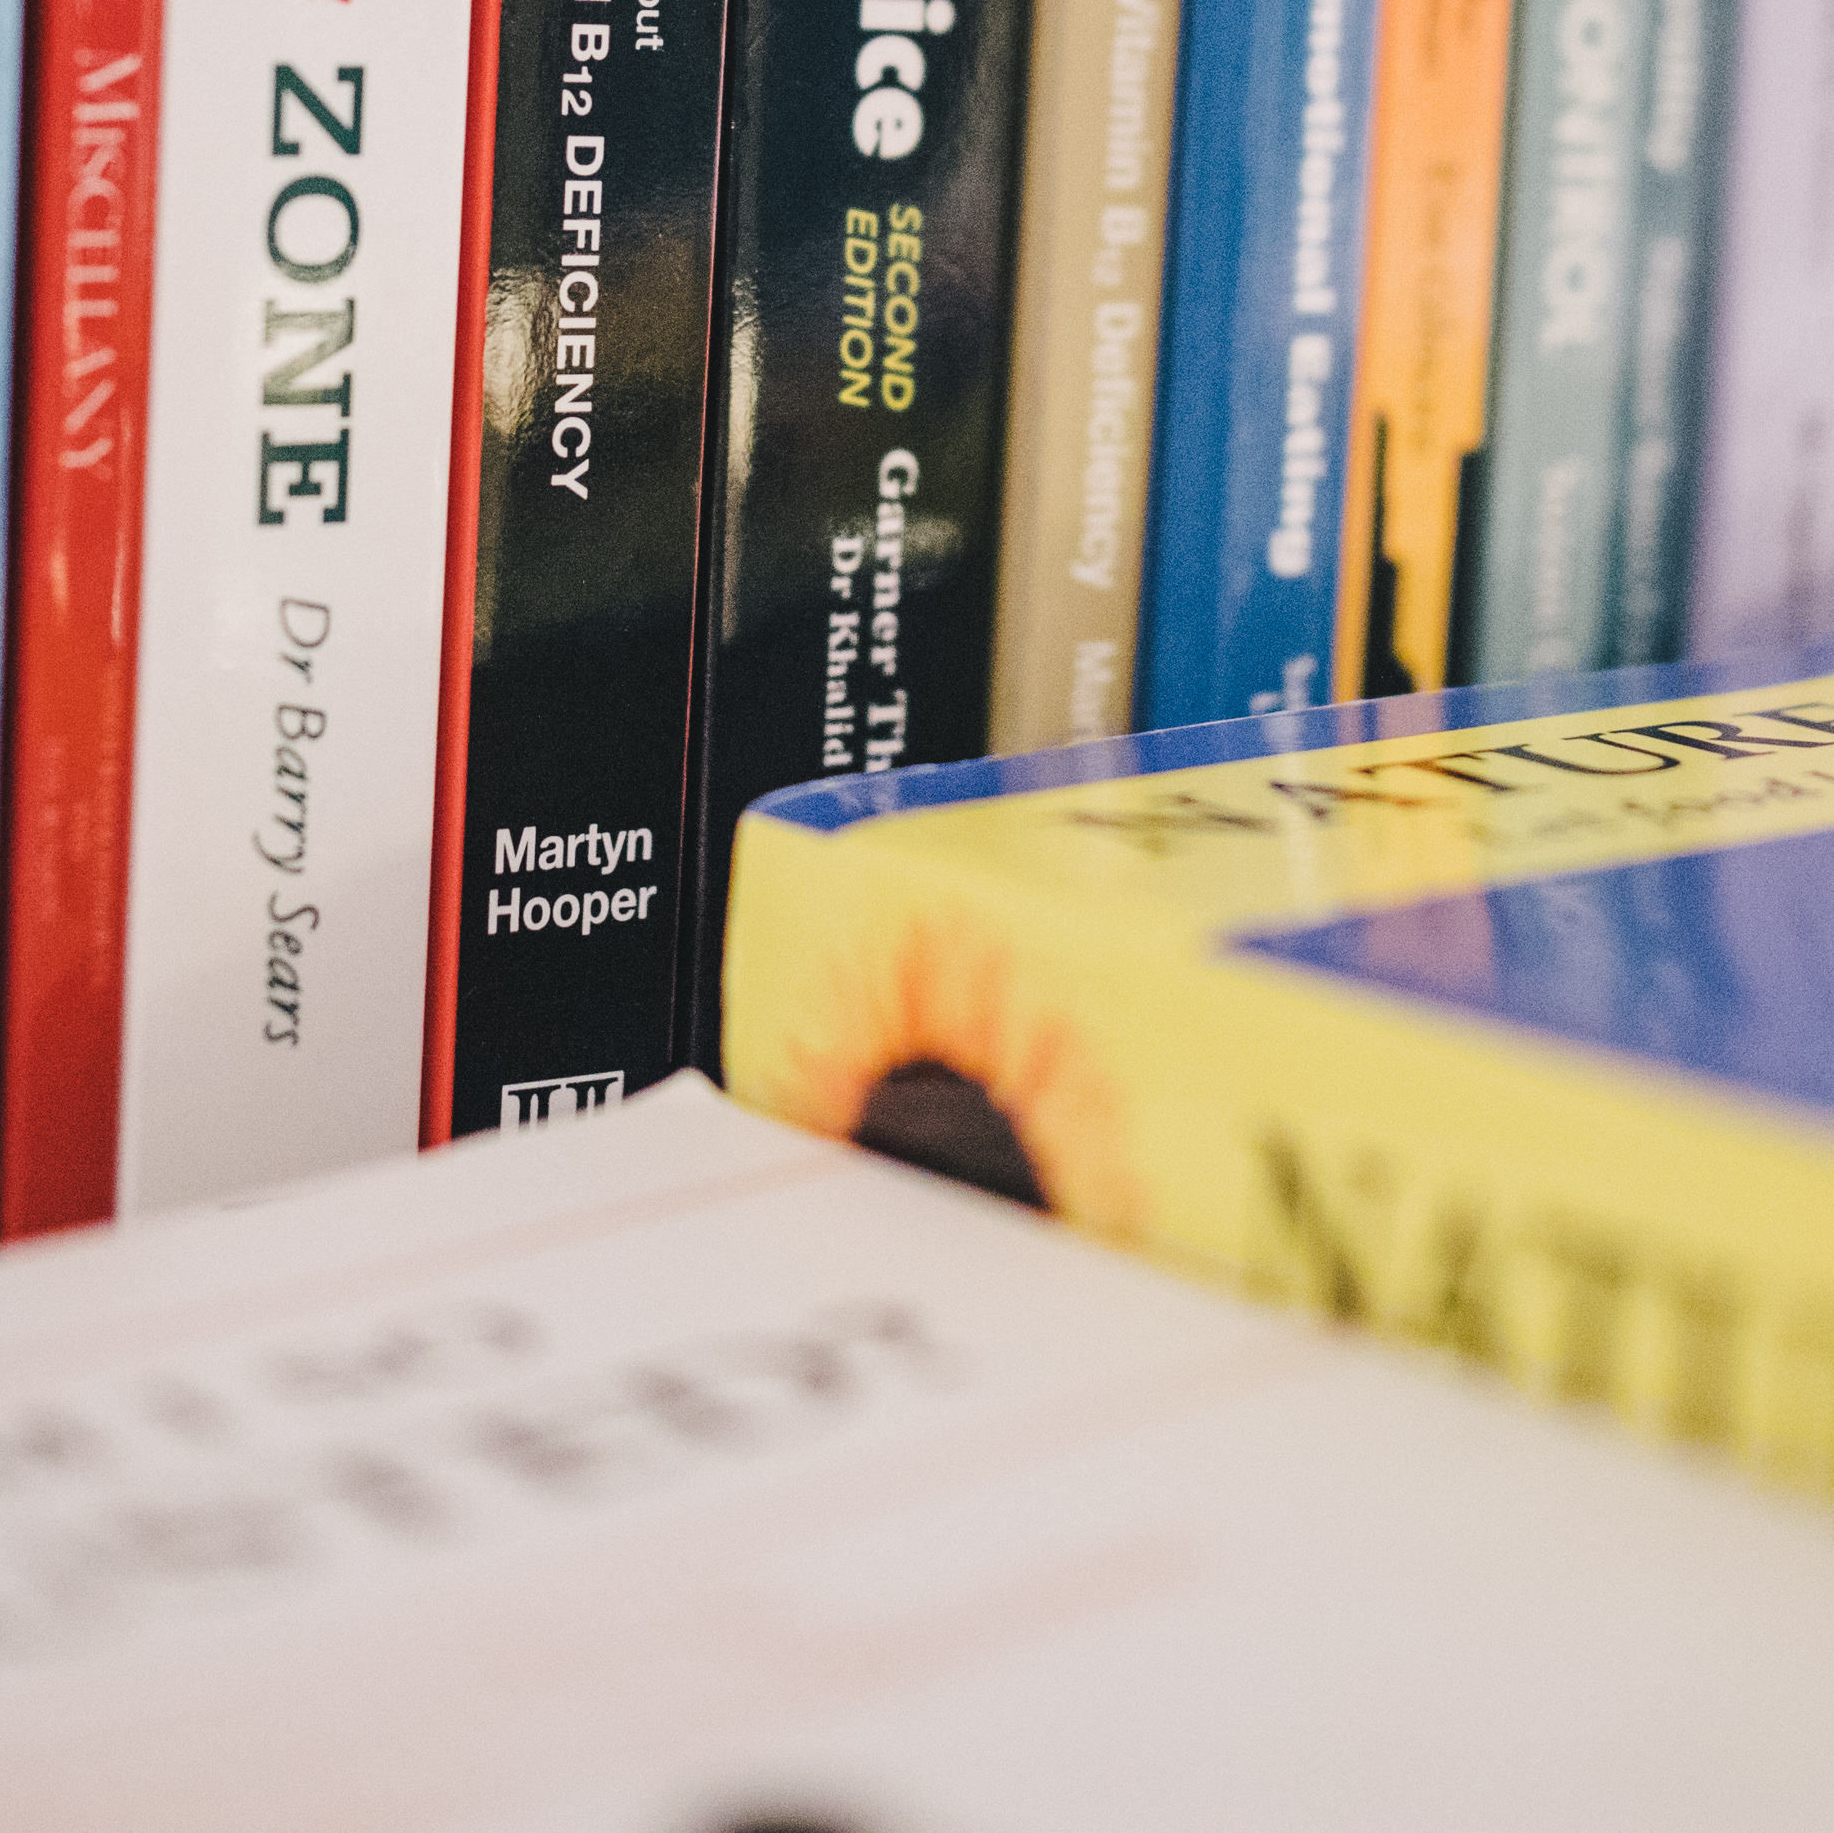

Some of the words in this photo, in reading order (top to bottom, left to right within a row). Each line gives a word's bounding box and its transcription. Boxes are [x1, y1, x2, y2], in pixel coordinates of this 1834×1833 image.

[560, 22, 610, 117] B12
[258, 61, 367, 530] ZONE
[550, 135, 606, 500] DEFICIENCY
[838, 206, 879, 409] EDITION
[880, 201, 922, 412] SECOND
[1067, 300, 1145, 592] Deficiency
[1267, 333, 1335, 578] Eating
[278, 597, 332, 686] Dr
[829, 535, 865, 602] Dr
[868, 447, 921, 678] Garner
[822, 610, 861, 769] Khalid
[252, 703, 329, 876] Barry
[493, 823, 654, 876] Martyn
[263, 891, 322, 1048] Sears
[486, 882, 658, 937] Hooper
